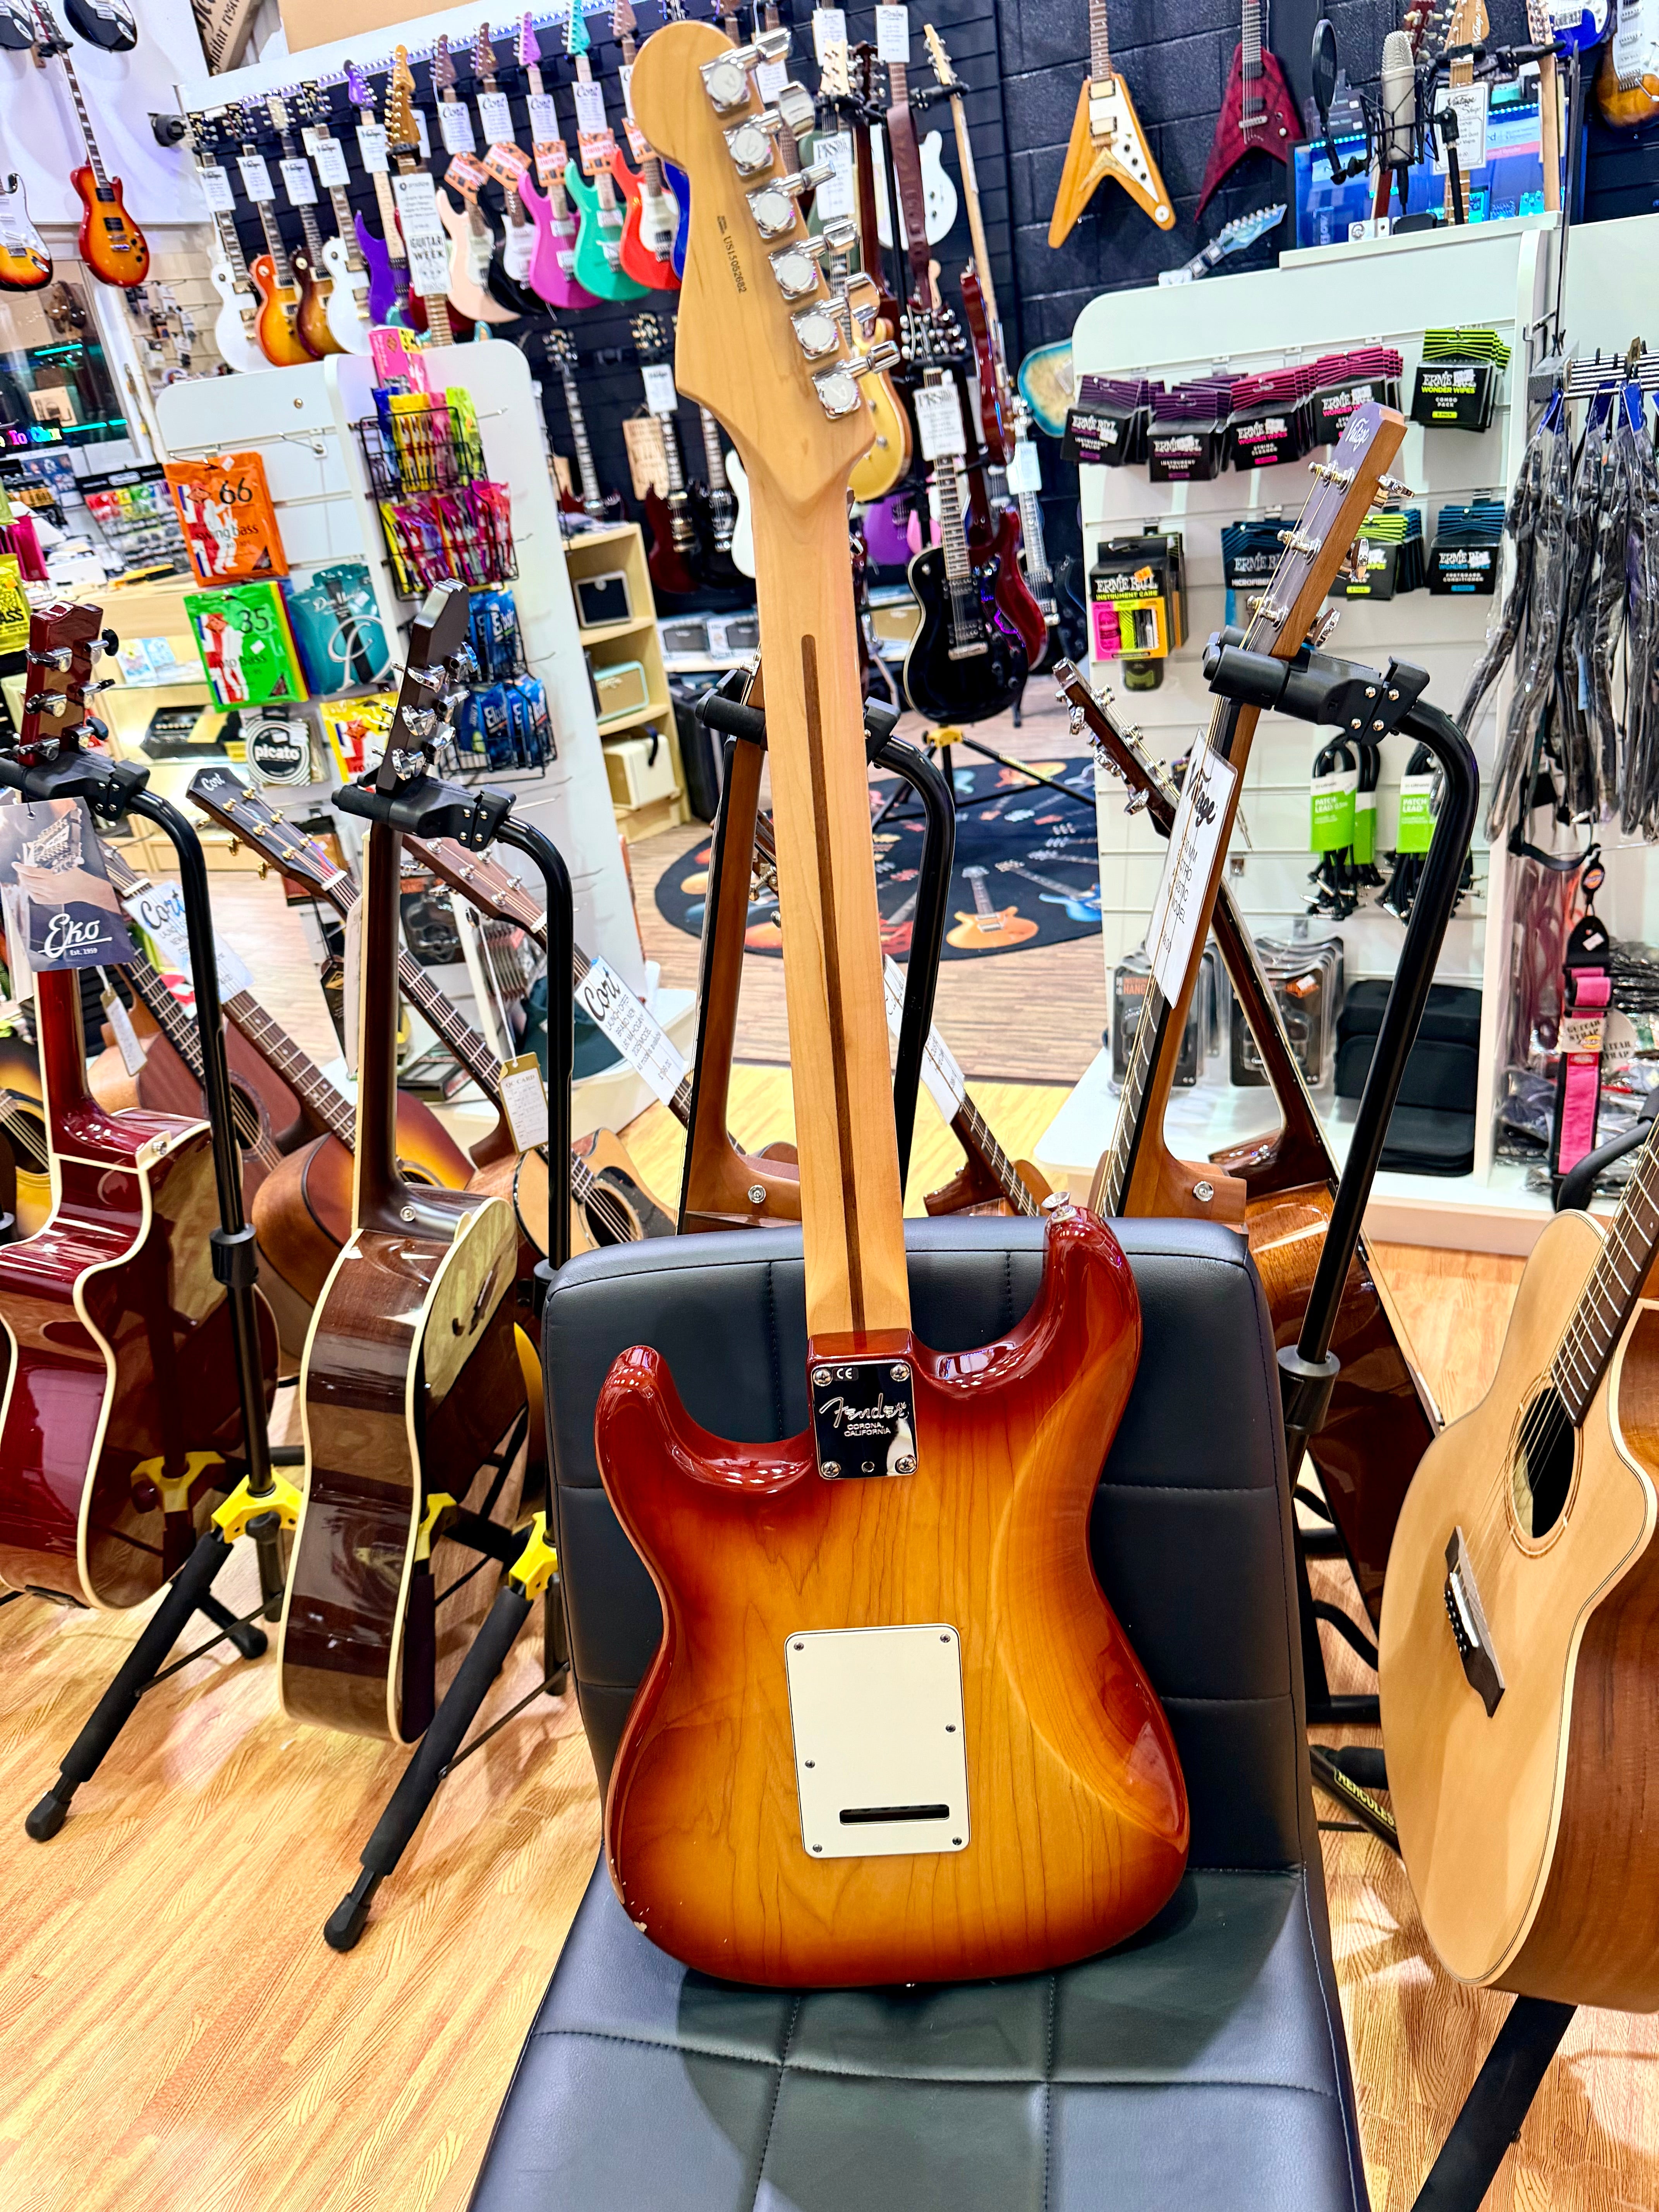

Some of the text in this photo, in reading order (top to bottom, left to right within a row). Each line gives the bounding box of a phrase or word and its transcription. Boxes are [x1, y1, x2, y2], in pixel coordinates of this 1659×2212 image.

[1422, 371, 1453, 387] ERNIE
[1321, 392, 1352, 411] ERNIE
[1323, 405, 1352, 417] WONDER
[1072, 414, 1097, 431] ERNIE
[1237, 420, 1265, 439] ERNIE
[1238, 431, 1288, 446] WONDER WIPES
[1345, 417, 1370, 452] Vintage
[219, 477, 253, 505] 66
[1233, 551, 1267, 572] ERNIE
[1439, 549, 1467, 565] ERNIE
[1094, 574, 1129, 593] ERNIE
[1096, 589, 1158, 601] INSTRUMENT CARE
[238, 607, 269, 634] 35
[254, 743, 300, 761] picato
[201, 773, 226, 792] Cort
[1315, 796, 1337, 805] PATCH
[1315, 803, 1333, 813] LEAD
[1402, 804, 1424, 813] LEAD
[1403, 797, 1427, 805] PATCH
[140, 890, 185, 930] Cort
[584, 967, 621, 1022] Cort
[517, 1074, 535, 1085] CARD
[819, 1393, 905, 1428] Fender
[844, 1427, 891, 1437] CALIFORNIA
[1338, 1770, 1395, 1827] HERCULES
